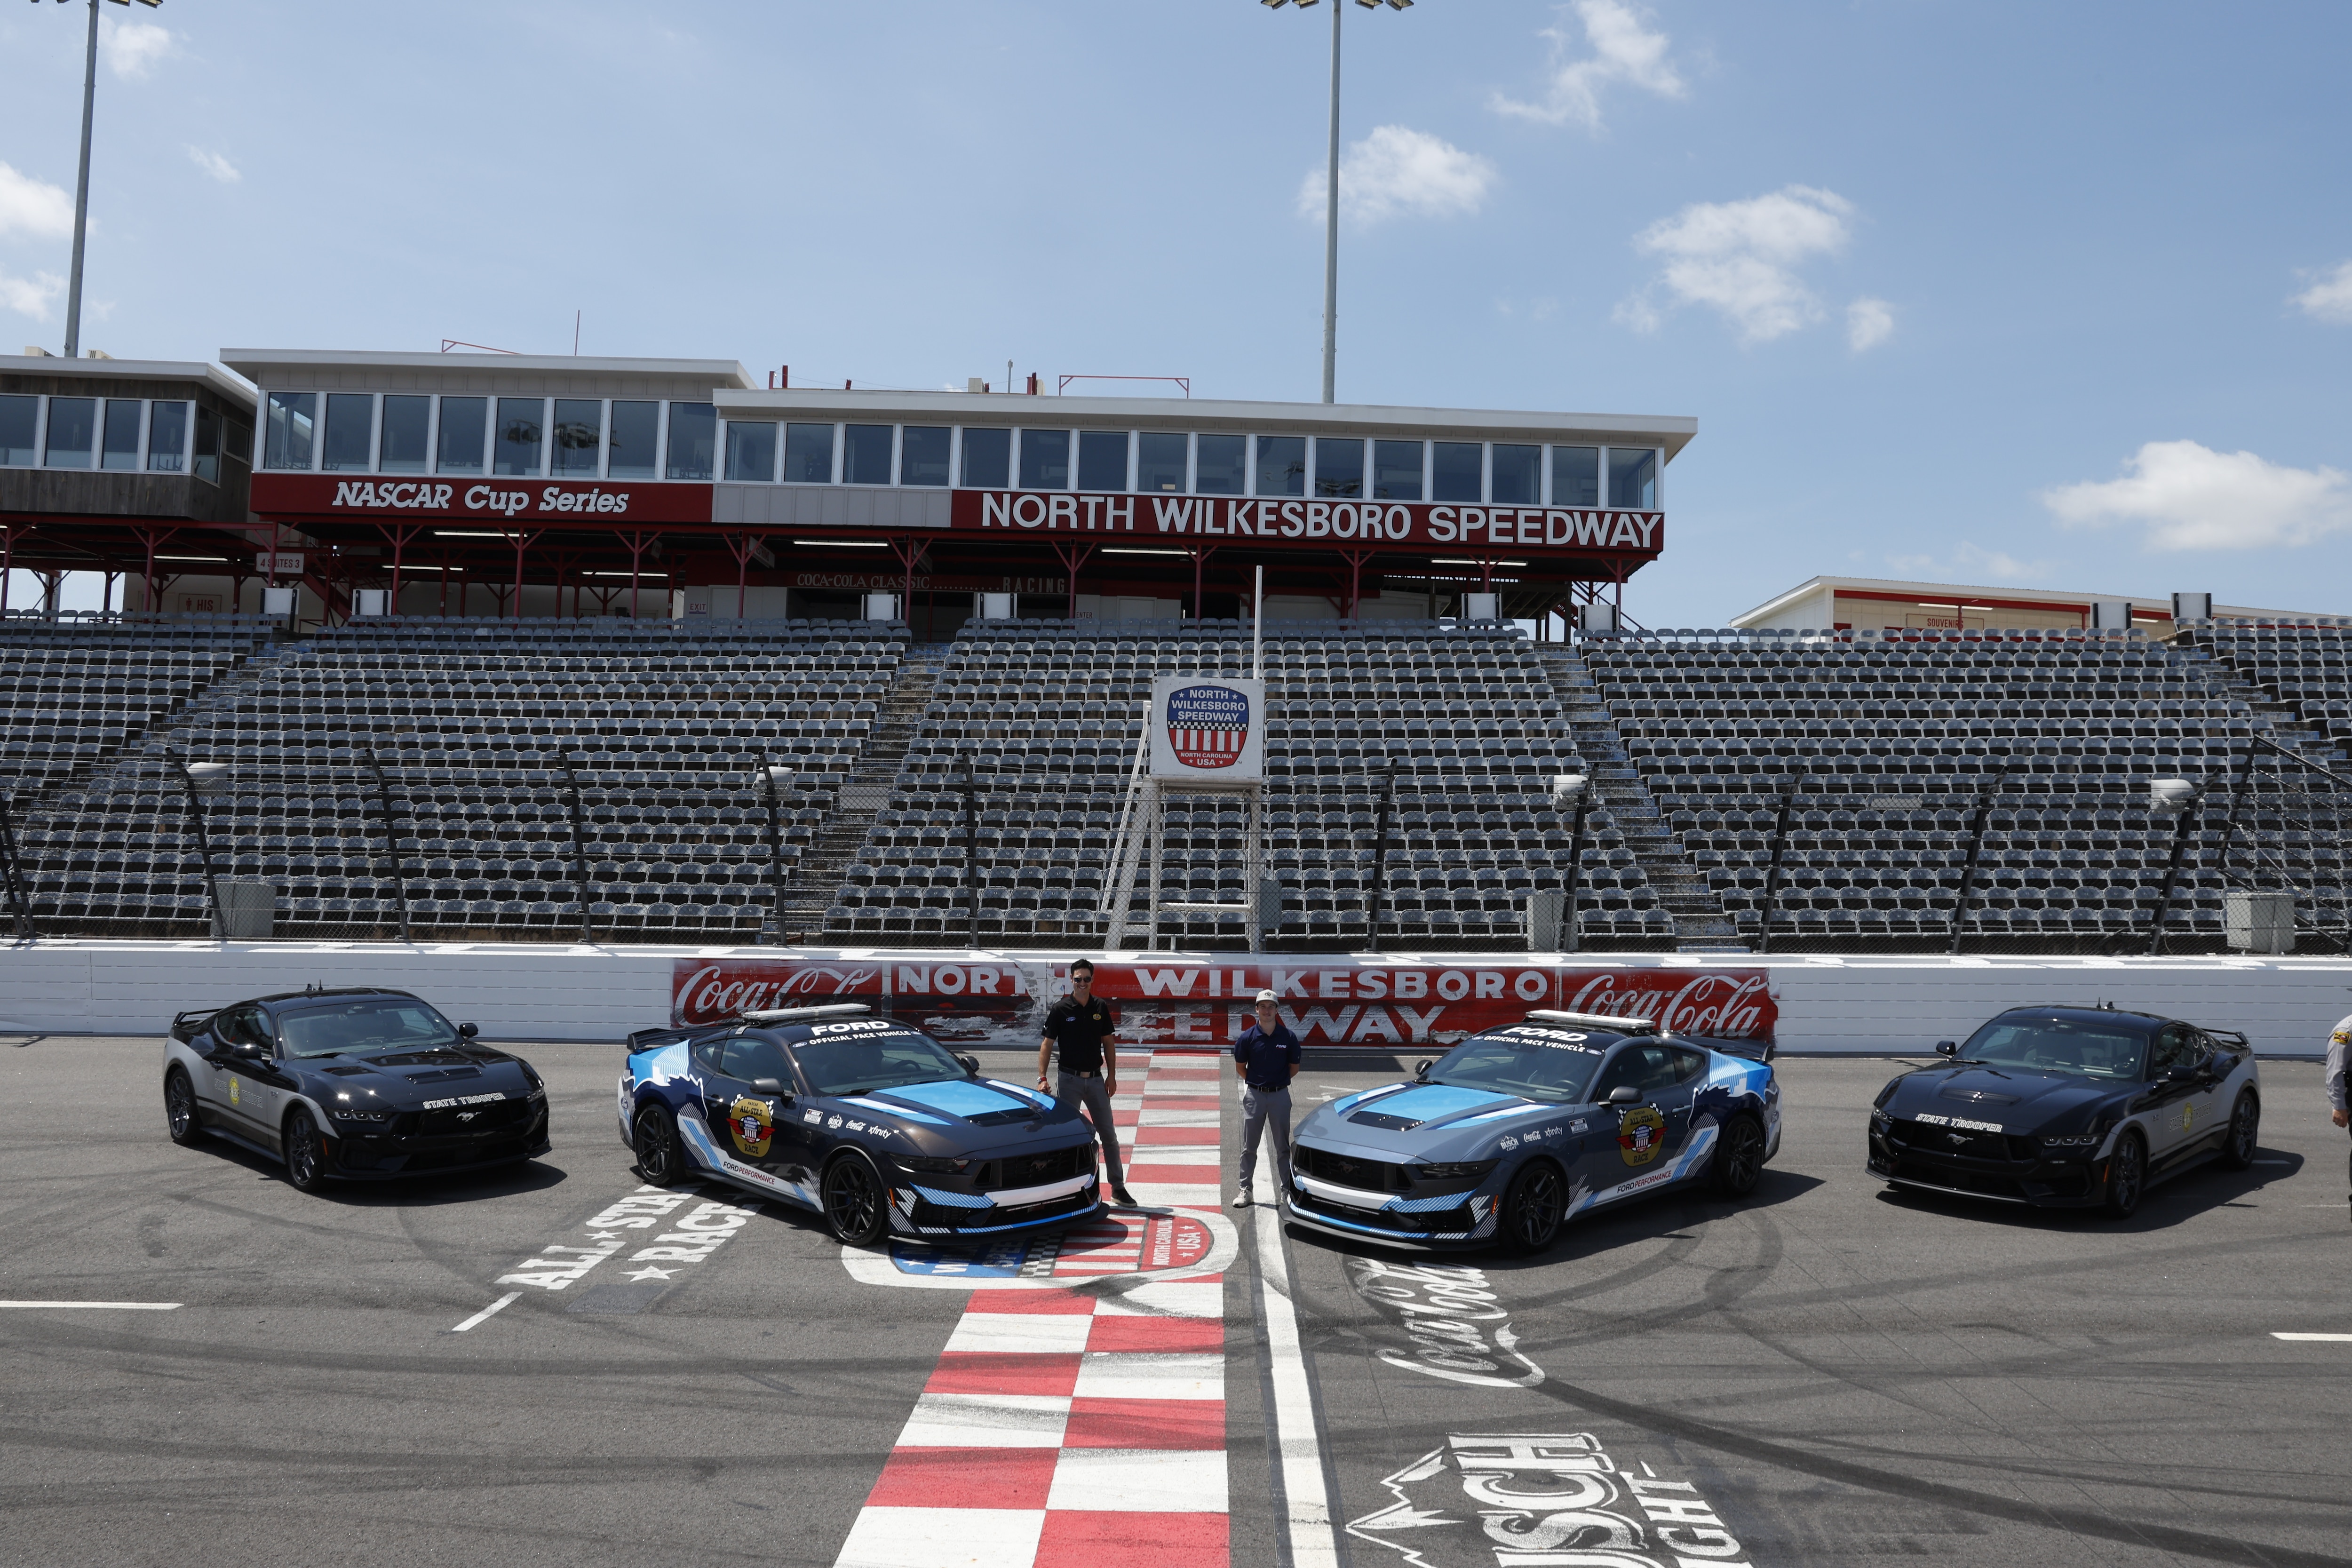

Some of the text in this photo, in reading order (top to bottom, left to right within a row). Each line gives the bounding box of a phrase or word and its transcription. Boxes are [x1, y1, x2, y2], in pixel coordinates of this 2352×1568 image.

[332, 481, 629, 516] NASCAR Cup Series
[982, 493, 1662, 548] NORTH WILKESBORO SPEEDWAY
[268, 559, 293, 568] SUITES
[295, 559, 300, 568] 3
[797, 573, 1065, 594] COCA-COLA CLASSIC RACING
[197, 599, 214, 611] HIS
[1927, 618, 1964, 629] SOUVENIRS
[1190, 689, 1229, 700] NORTH
[1171, 700, 1246, 711] WILKESBORO
[1177, 711, 1239, 722] SPEEDWAY
[1134, 969, 1548, 1001] WILKESBORO
[1567, 974, 1768, 1038] Coca-Cola
[810, 1021, 890, 1036] FORD
[1501, 1027, 1588, 1042] FORD
[809, 1035, 852, 1045] OFFICIAL
[1484, 1035, 1519, 1043] OFFICIAL
[1546, 1041, 1586, 1053] VEHICLE
[422, 1092, 507, 1109] STATE TROOPER
[827, 1117, 843, 1128] BUSCH
[1915, 1113, 2003, 1133] STATE TROOPER
[867, 1125, 892, 1139] xfinity
[1544, 1126, 1563, 1138] xfinity
[744, 1144, 759, 1154] RACE
[1500, 1138, 1519, 1150] BUSCH
[1633, 1153, 1649, 1163] RACE
[628, 1202, 765, 1263] RACE
[1152, 1218, 1173, 1266] NORTH CAROLINA
[1177, 1232, 1201, 1250] USA
[493, 1241, 628, 1290] ALL
